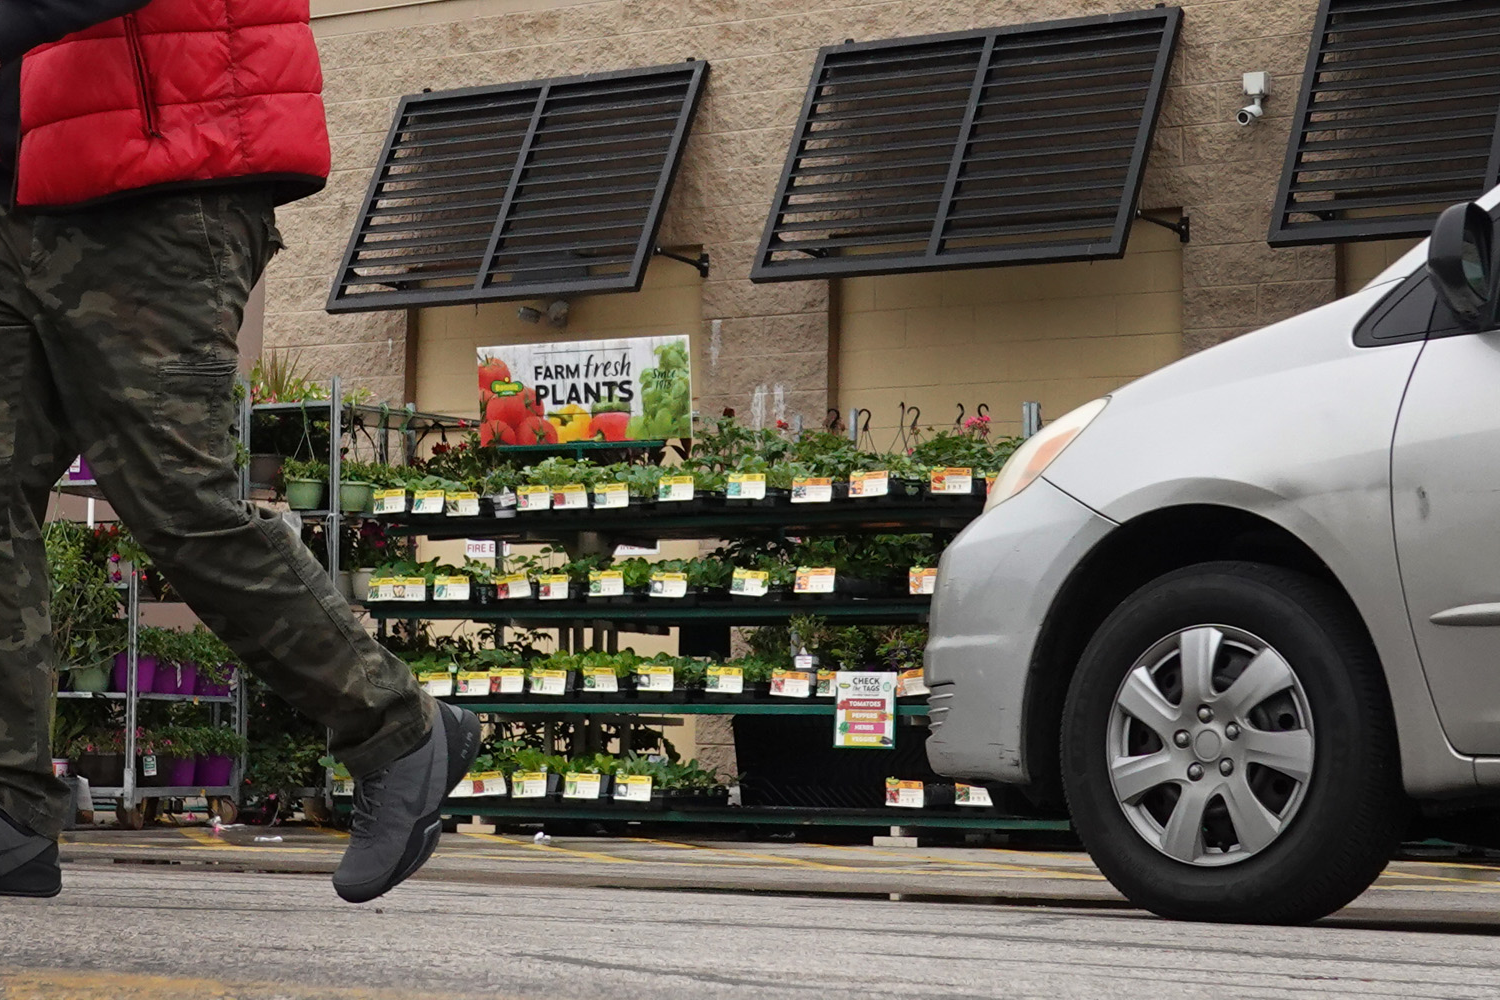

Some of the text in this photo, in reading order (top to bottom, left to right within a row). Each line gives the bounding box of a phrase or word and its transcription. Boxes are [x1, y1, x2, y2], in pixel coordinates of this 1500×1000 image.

[534, 353, 632, 381] FARM fresh
[534, 380, 634, 406] PLANTS
[467, 543, 508, 553] FIRE ET
[852, 677, 880, 685] CHECK
